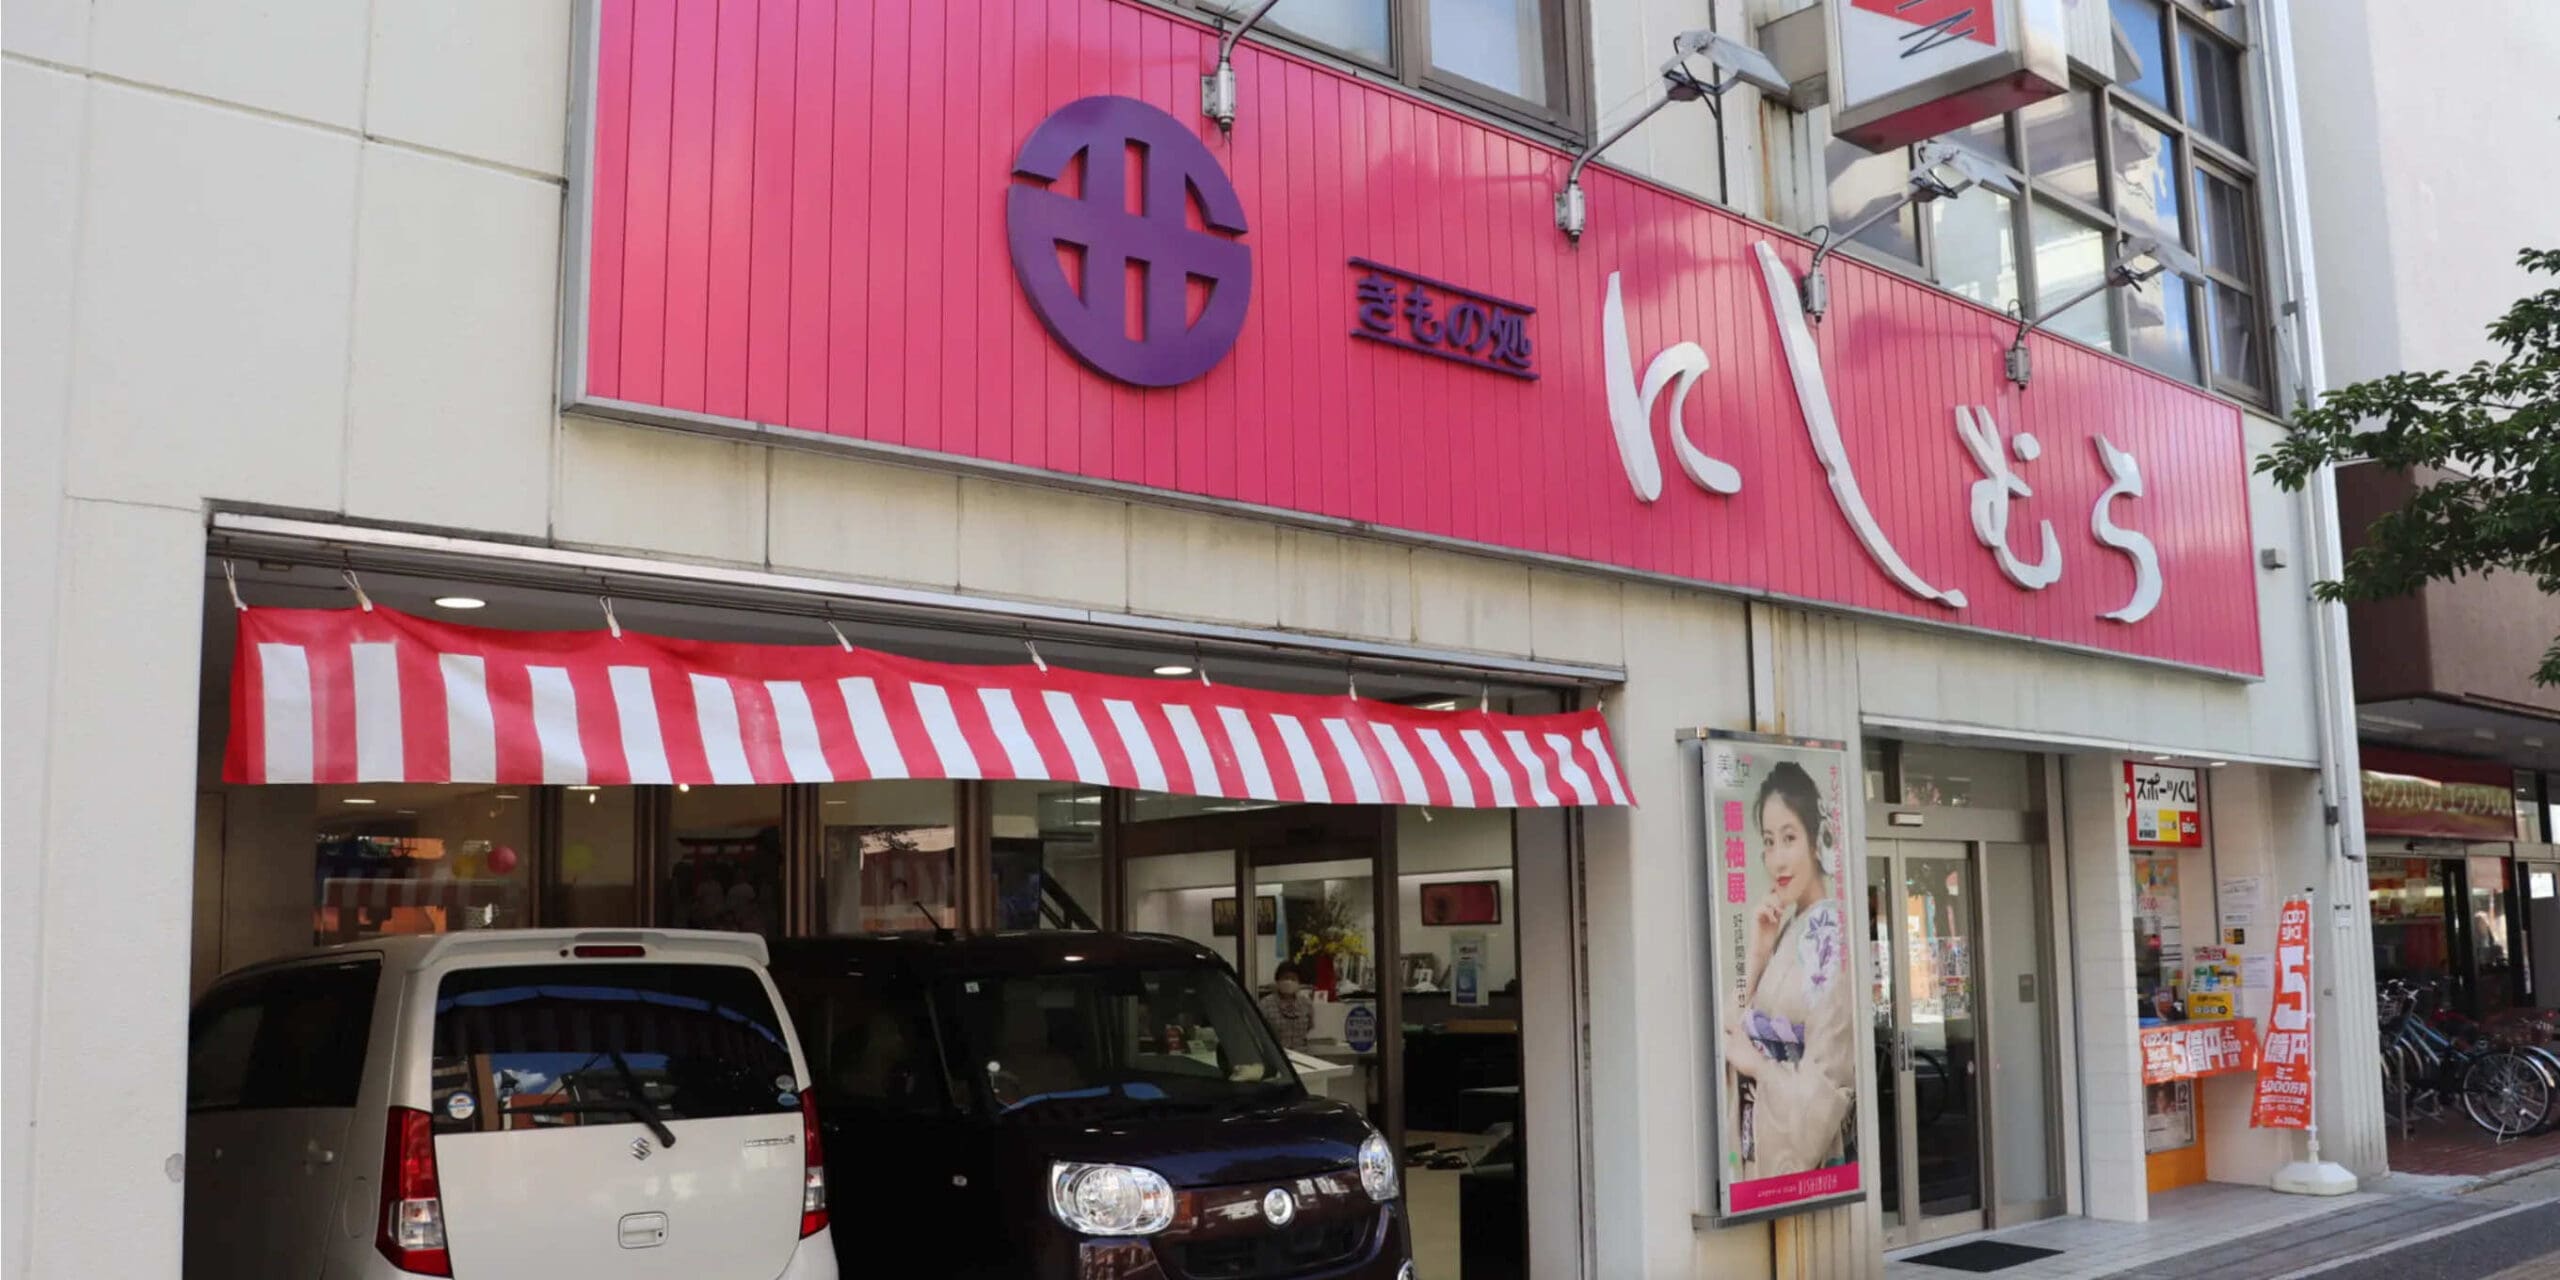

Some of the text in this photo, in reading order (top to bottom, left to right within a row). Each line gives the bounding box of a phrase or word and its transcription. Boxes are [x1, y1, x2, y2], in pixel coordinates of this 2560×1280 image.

[1357, 272, 1533, 368] きもの処
[1603, 240, 2163, 624] にしむら
[2136, 773, 2196, 803] スポーツくじ
[2274, 946, 2308, 1031] 5
